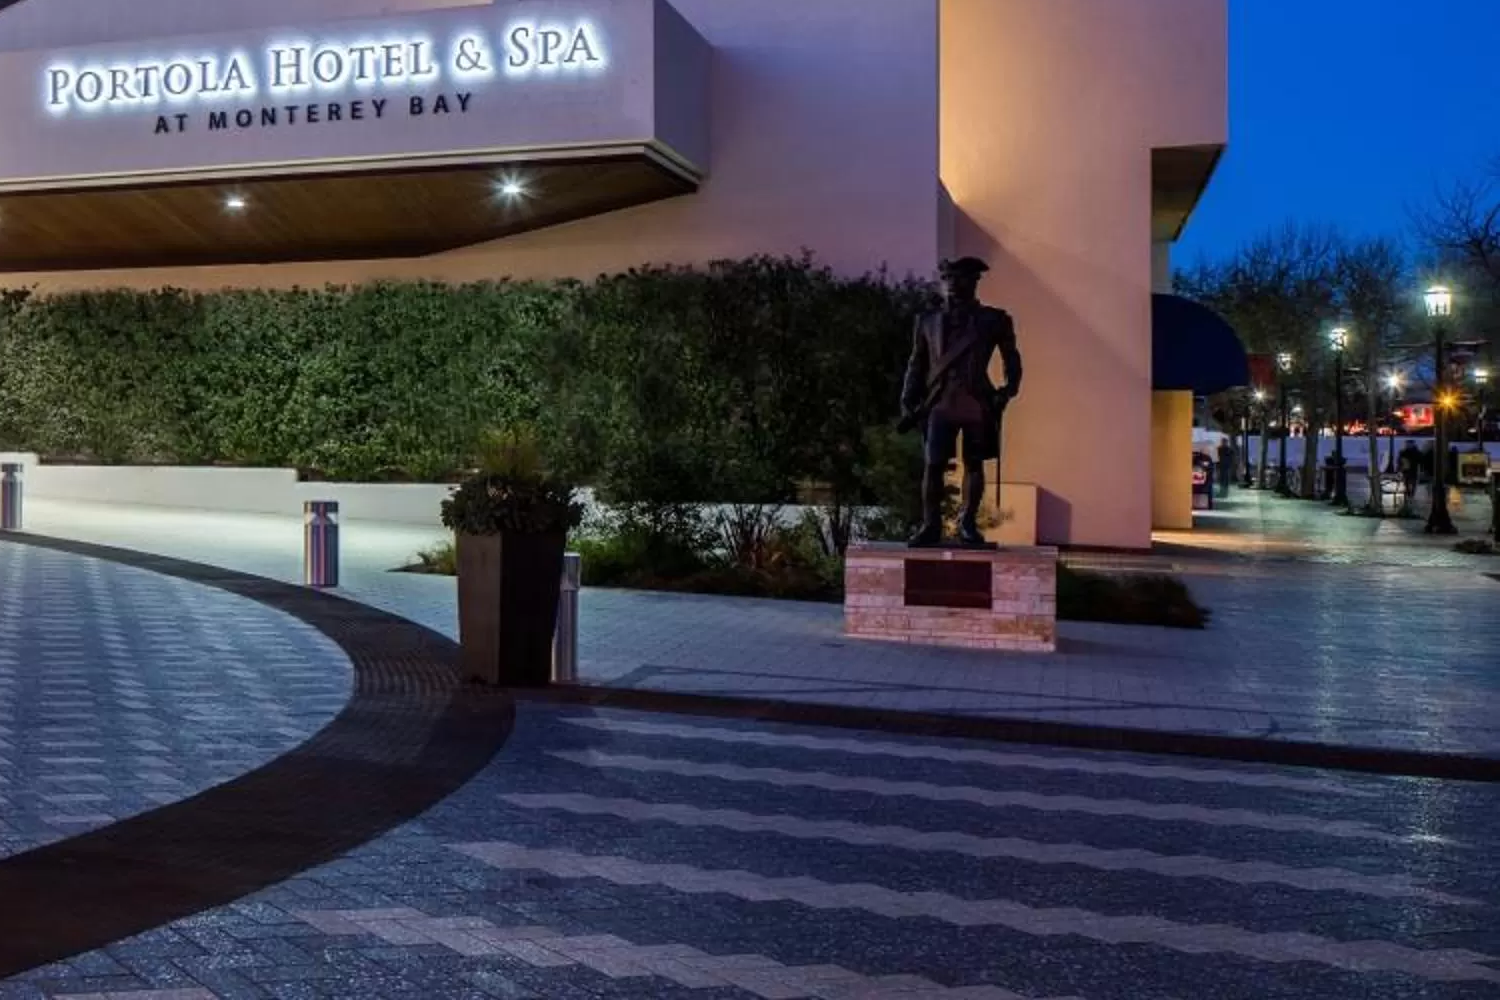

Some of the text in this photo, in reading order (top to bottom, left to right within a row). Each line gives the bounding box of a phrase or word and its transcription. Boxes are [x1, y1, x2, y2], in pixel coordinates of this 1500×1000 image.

[49, 26, 599, 105] PORTOLA HOTEL & SPA
[154, 92, 472, 134] AT MONTEREY BAY
